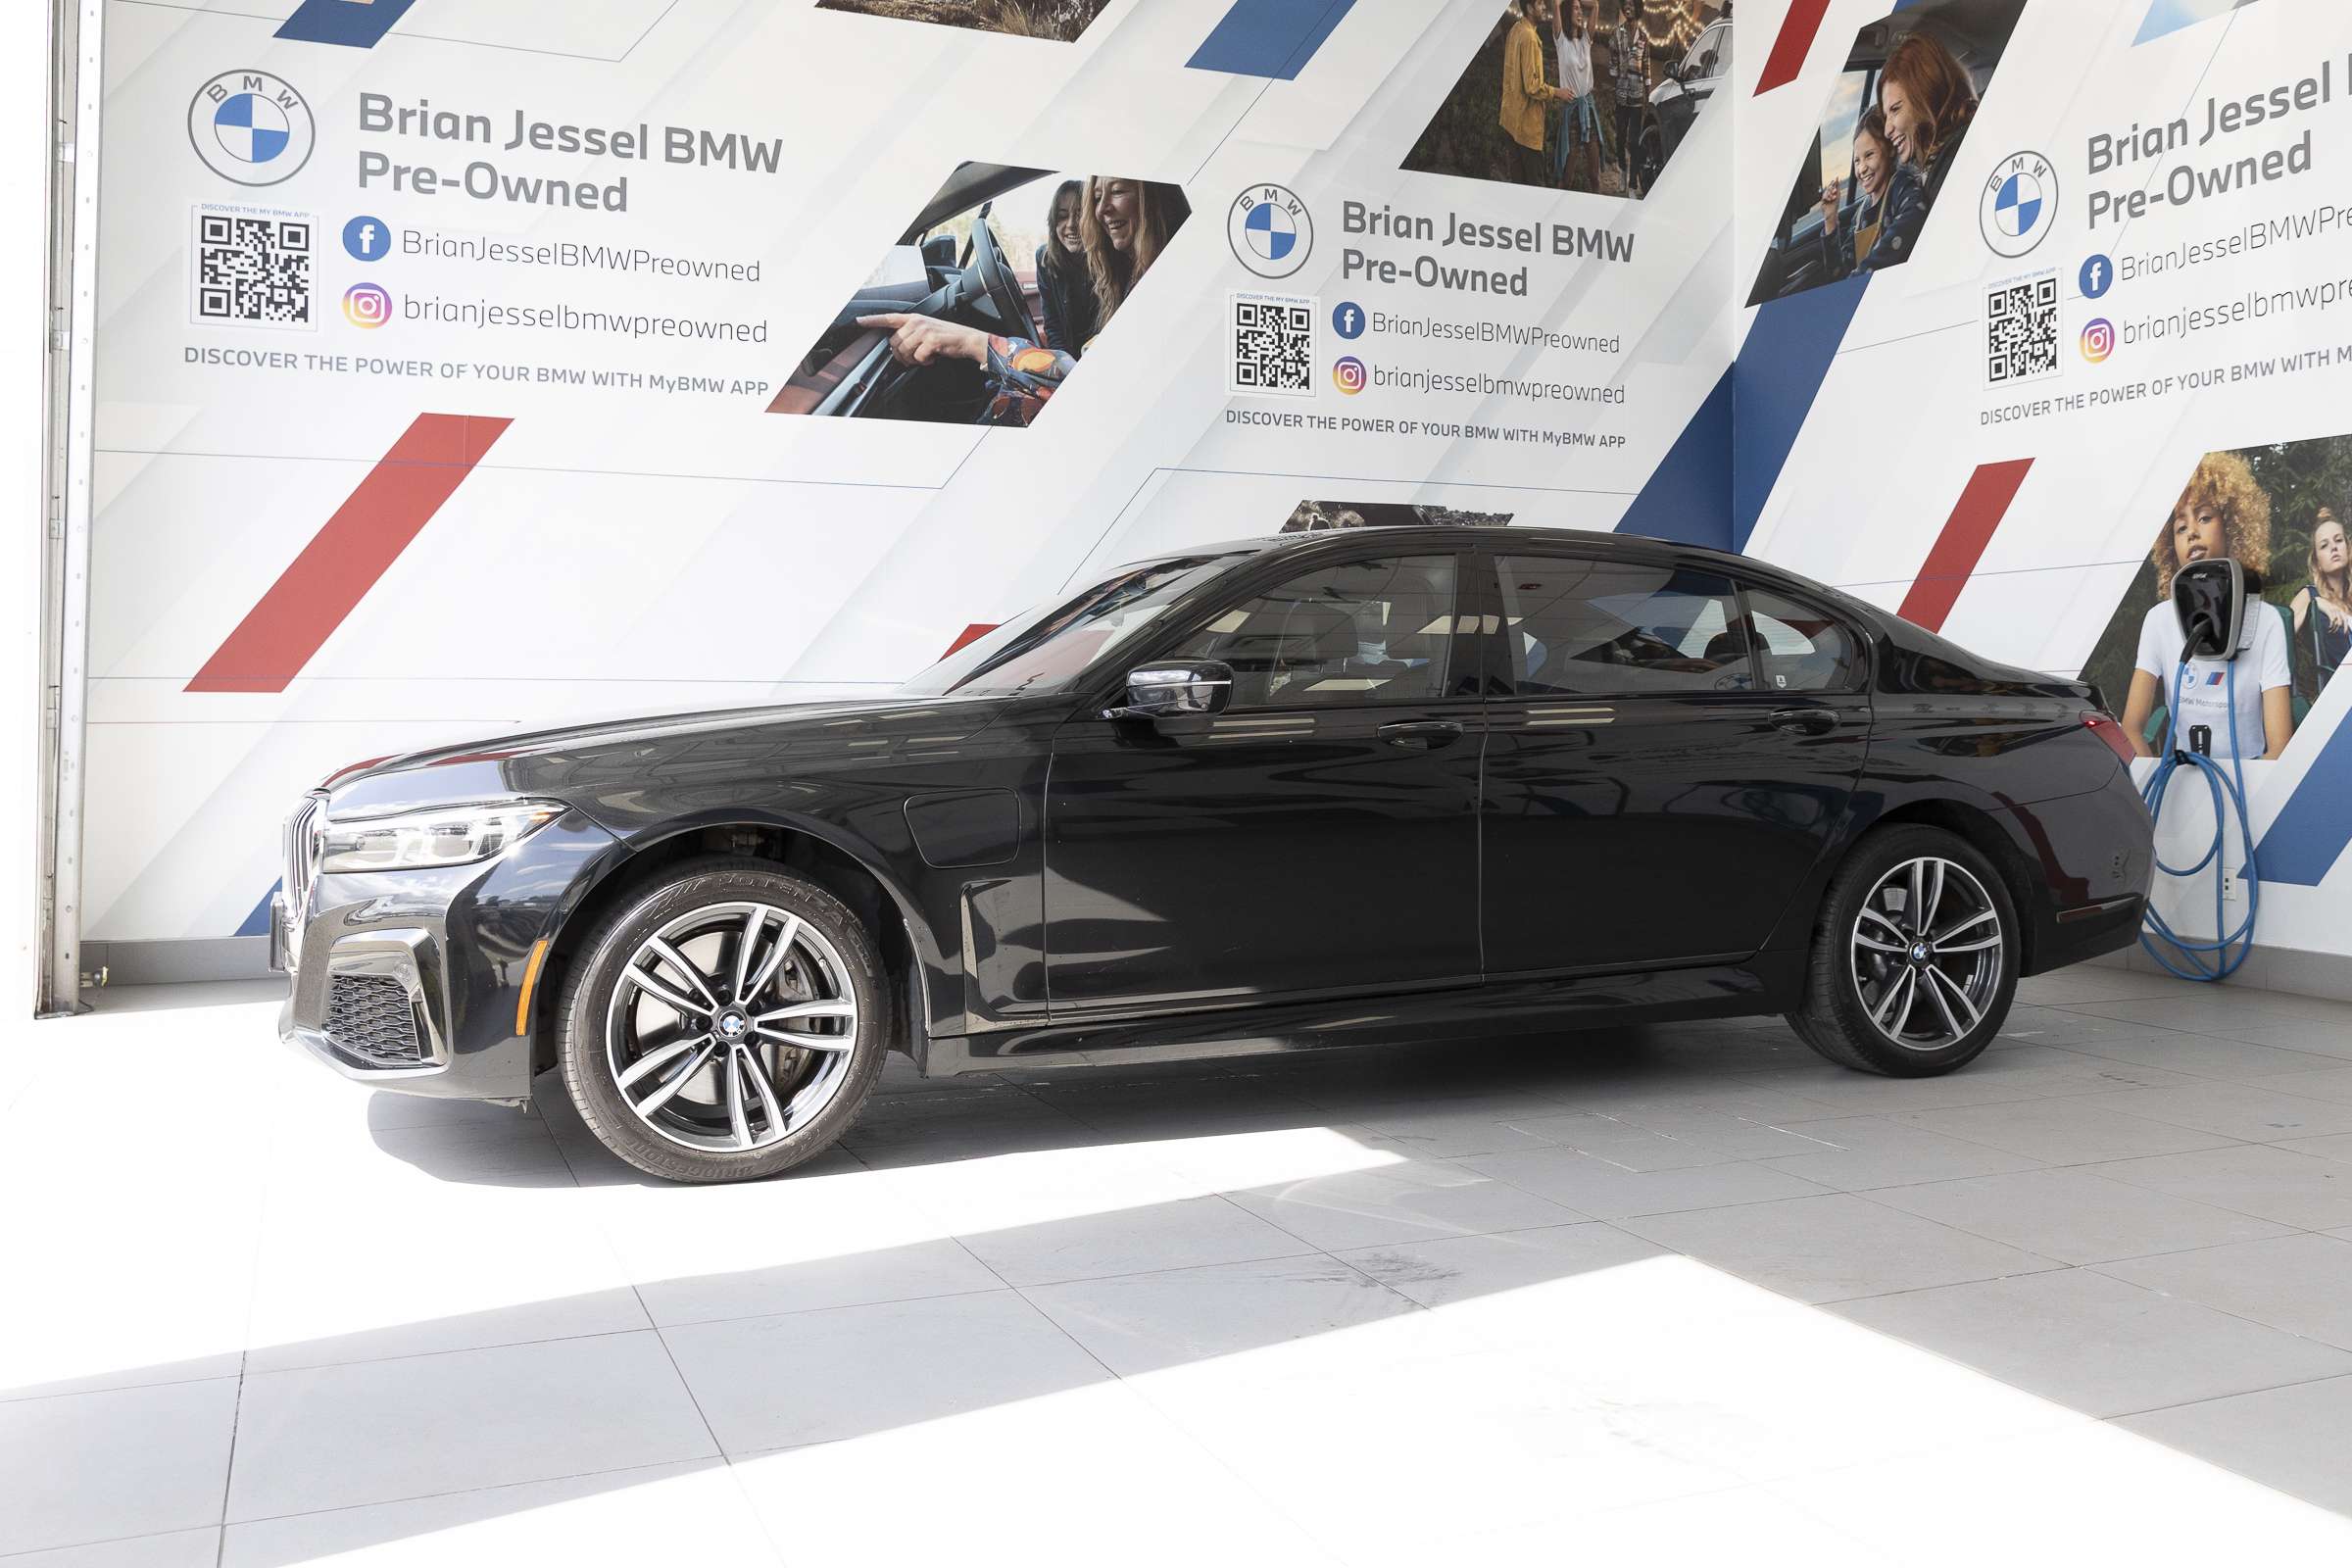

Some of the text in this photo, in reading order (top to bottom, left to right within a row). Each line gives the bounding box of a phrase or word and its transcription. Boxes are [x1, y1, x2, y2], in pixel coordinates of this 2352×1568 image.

[207, 74, 299, 112] BMW
[2087, 118, 2188, 174] Brian
[2199, 60, 2330, 145] Jessel
[359, 92, 783, 174] Brian Jessel BMW
[358, 151, 628, 213] Pre-Owned
[1989, 156, 2047, 192] BMW
[2088, 129, 2312, 229] Pre-Owned
[202, 204, 240, 213] DISCOVER
[1240, 188, 1301, 217] BMW
[403, 229, 760, 283] BrianJesselBMWPreowned
[1343, 201, 1635, 263] Brian Jessel BMW
[1343, 249, 1528, 296] Pre-Owned
[405, 294, 767, 344] brianjesselbmwpreowned
[1373, 313, 1620, 353] BrianJesselBMWPreowned
[184, 346, 769, 397] DISCOVER THE POWER OF YOUR BMW WITH MyBMW APP
[1374, 365, 1625, 404] brianjesselbmwpreowned
[1981, 399, 2051, 425] DISCOVER
[2055, 394, 2084, 412] THE
[2089, 382, 2146, 407] POWER
[2152, 376, 2174, 395] OF
[2177, 368, 2225, 390] YOUR
[2230, 362, 2276, 381] BMW
[2281, 352, 2330, 372] WITH
[1226, 410, 1626, 448] DISCOVER THE POWER OF YOUR BMW WITH MyBMW APP
